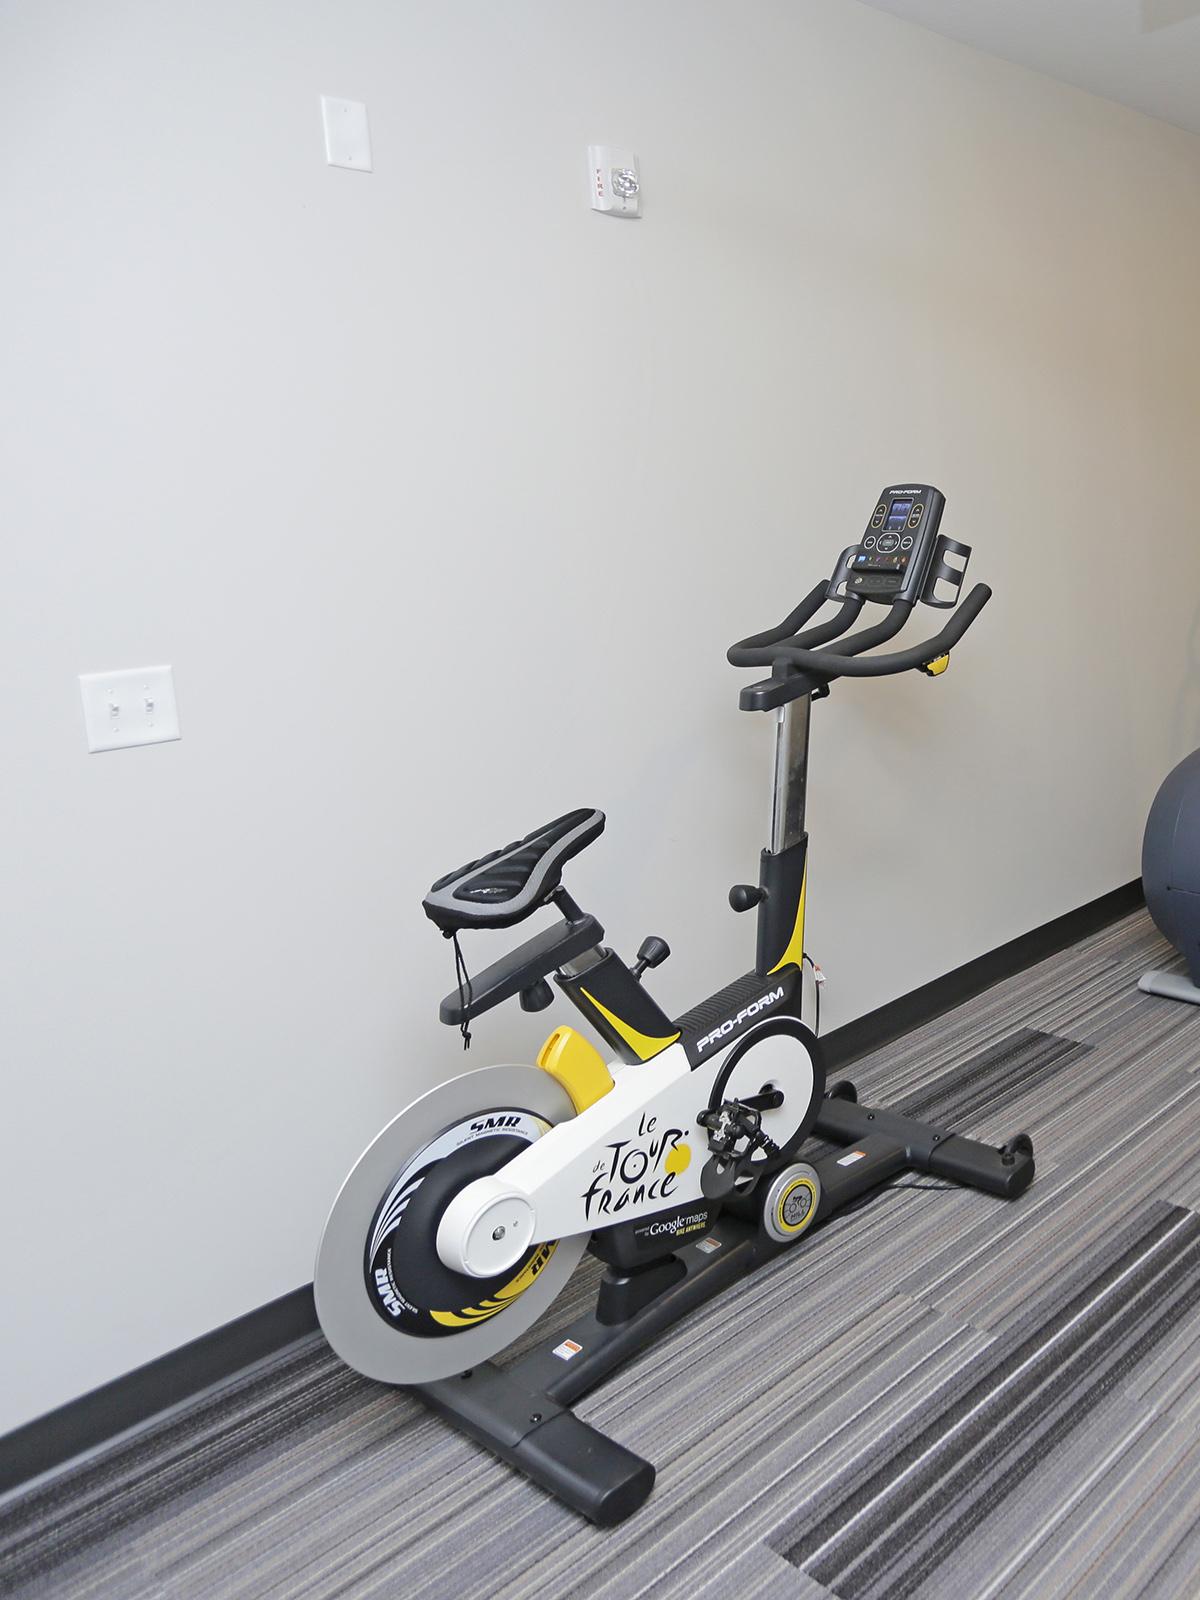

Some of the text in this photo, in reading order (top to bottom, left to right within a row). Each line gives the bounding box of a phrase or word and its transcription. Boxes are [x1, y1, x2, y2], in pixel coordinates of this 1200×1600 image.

[696, 986, 784, 1053] PRO-FORM
[469, 1116, 521, 1134] SMR
[650, 1211, 708, 1236] Google maps
[375, 1268, 405, 1317] SMR
